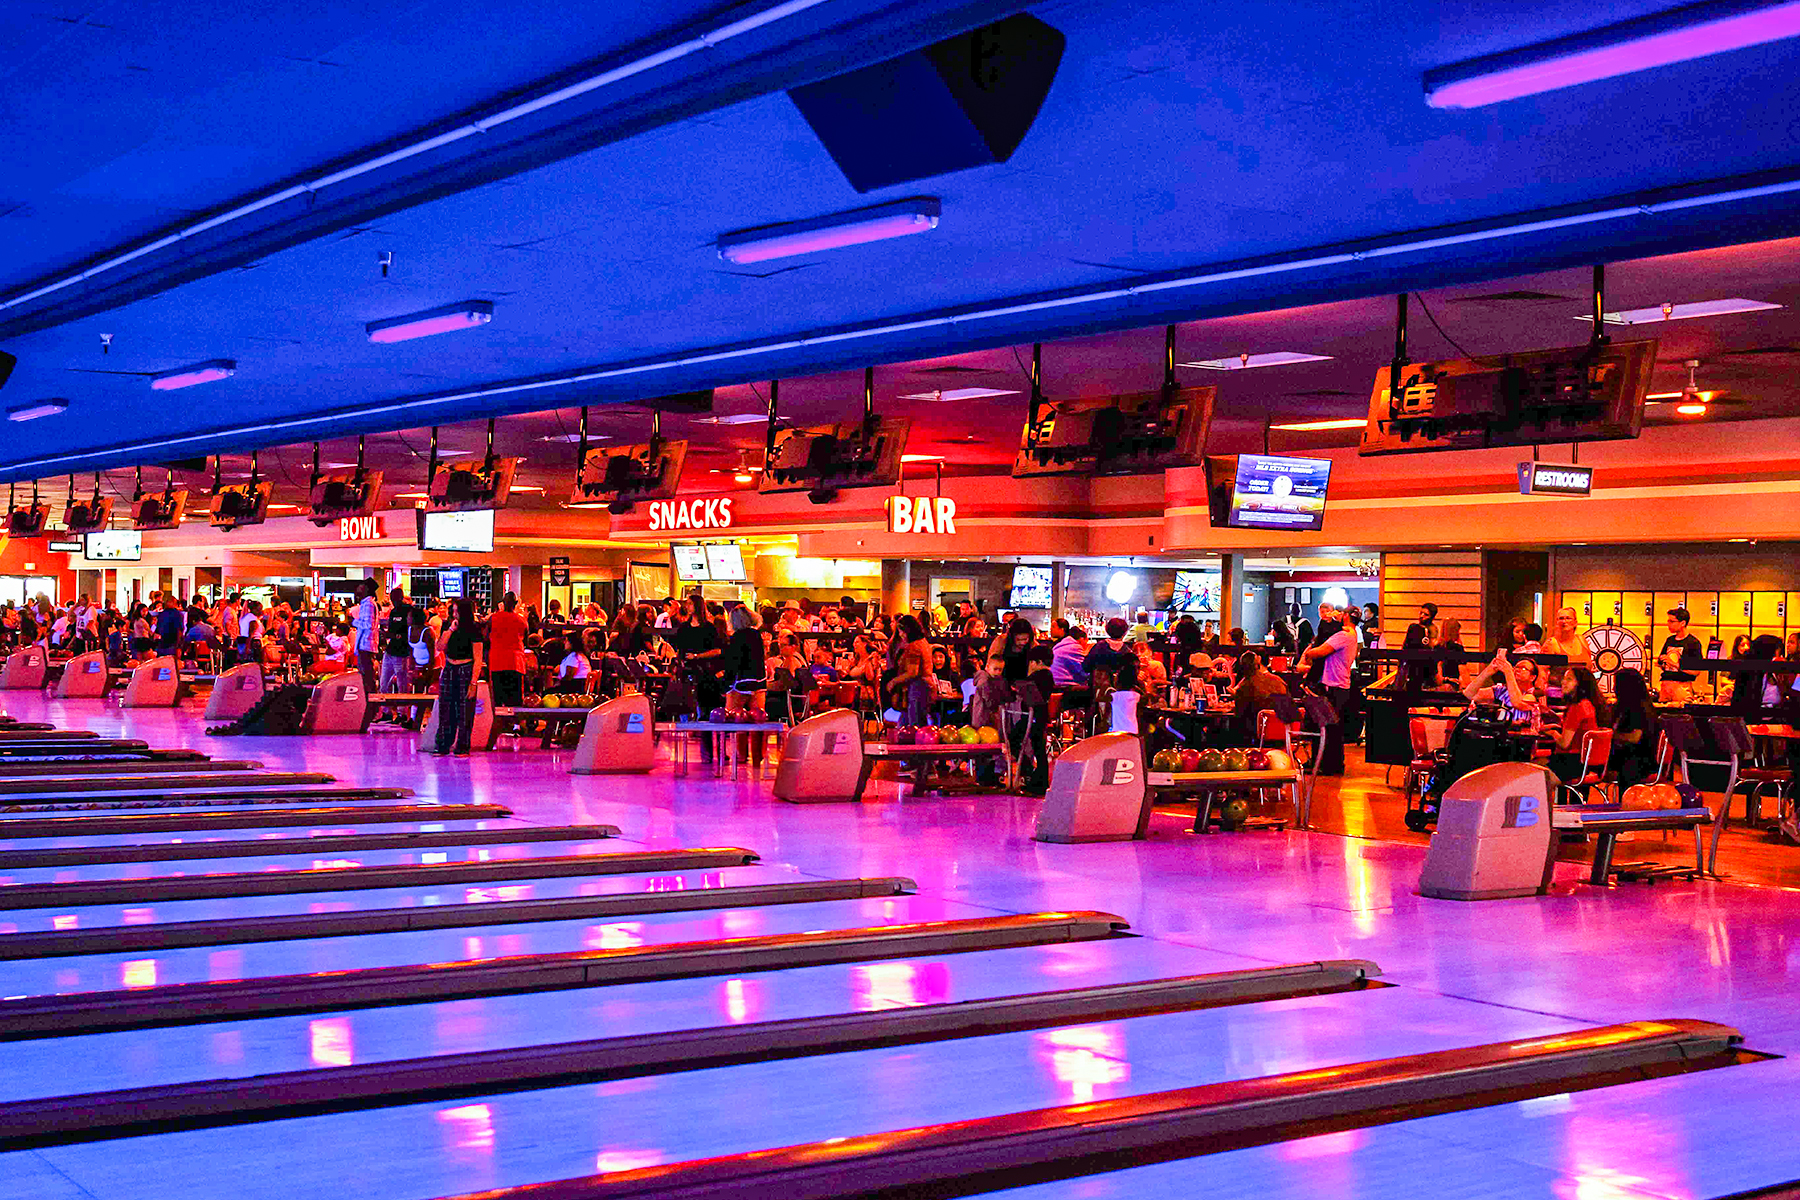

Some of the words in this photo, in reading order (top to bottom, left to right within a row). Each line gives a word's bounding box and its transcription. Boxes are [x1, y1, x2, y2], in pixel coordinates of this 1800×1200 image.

[1534, 470, 1590, 488] RESTROOMS
[340, 516, 380, 540] BOWL
[649, 498, 732, 530] SNACKS
[892, 496, 956, 534] BAR
